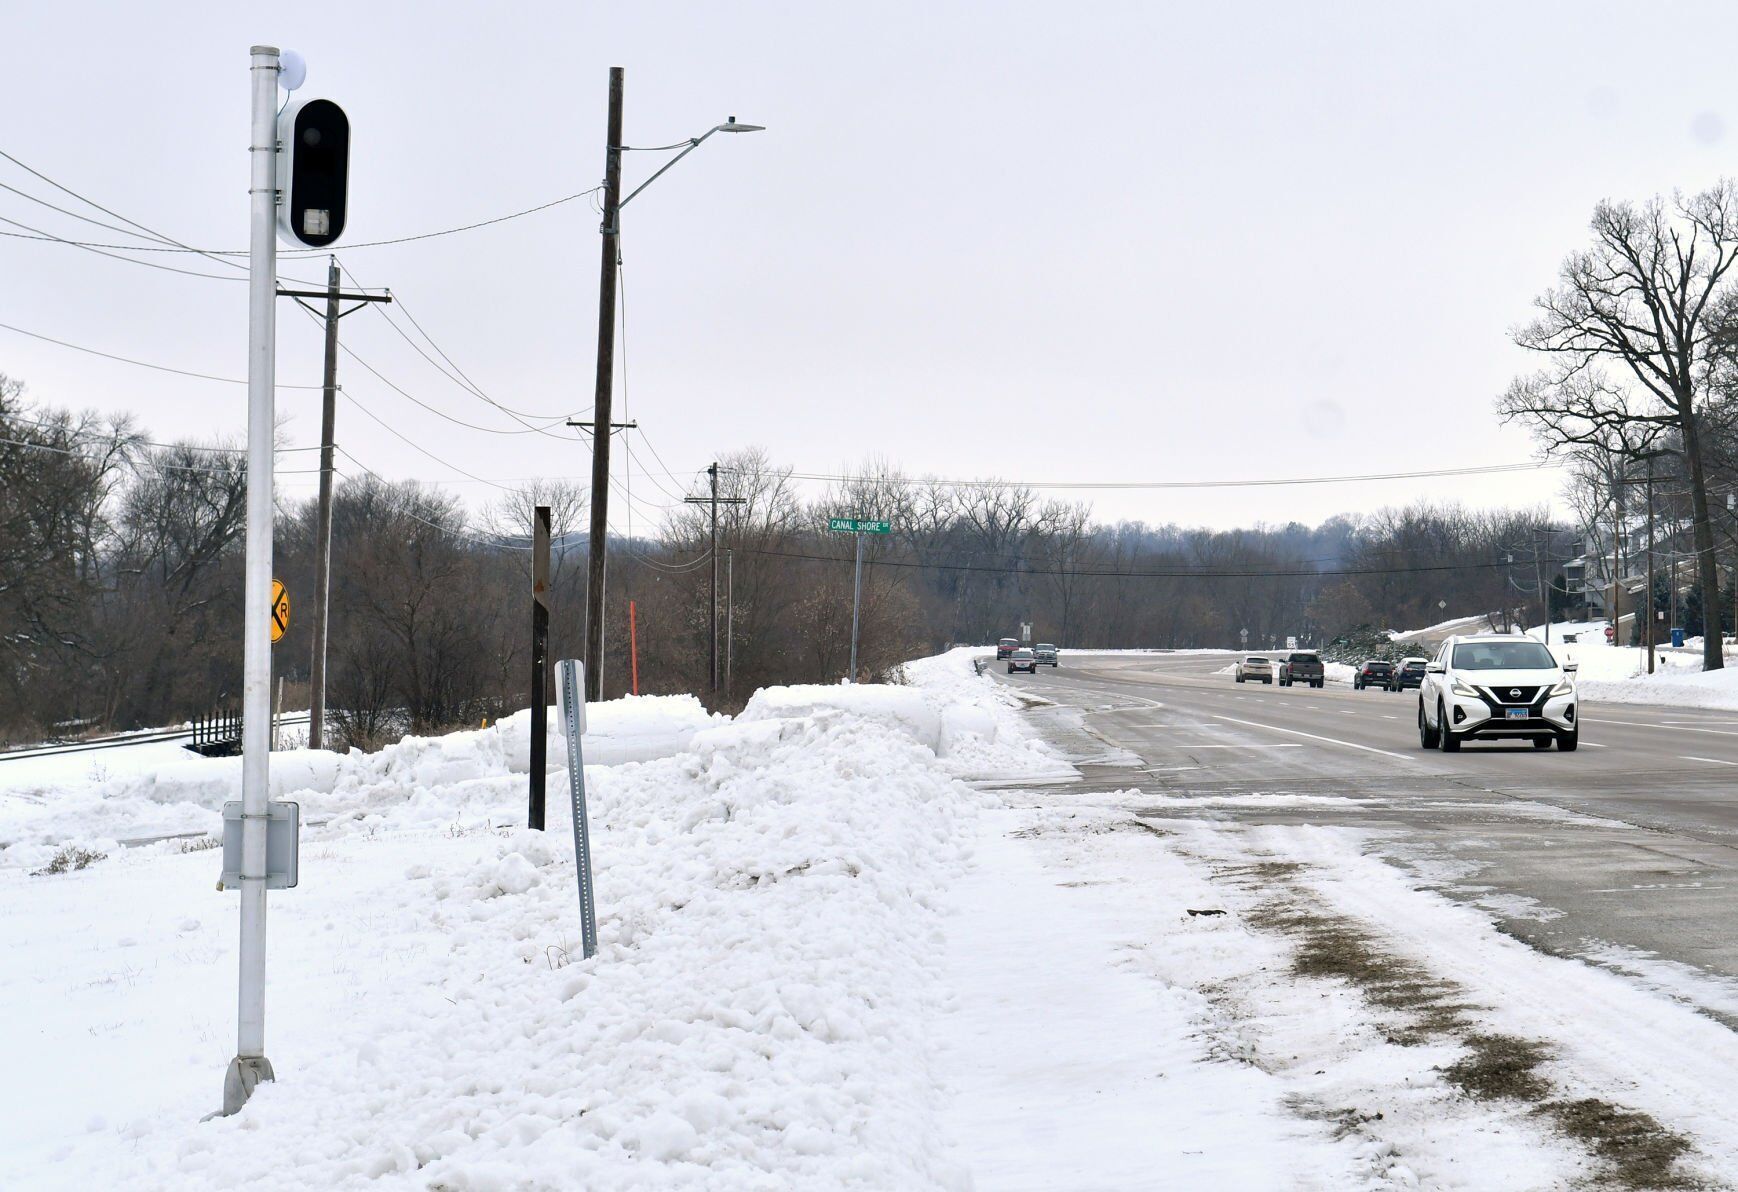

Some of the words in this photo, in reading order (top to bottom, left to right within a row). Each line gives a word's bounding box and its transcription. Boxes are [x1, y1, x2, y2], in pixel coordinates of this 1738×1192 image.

[831, 520, 853, 530] CANAL
[857, 521, 881, 531] SHORE
[281, 603, 288, 618] R
